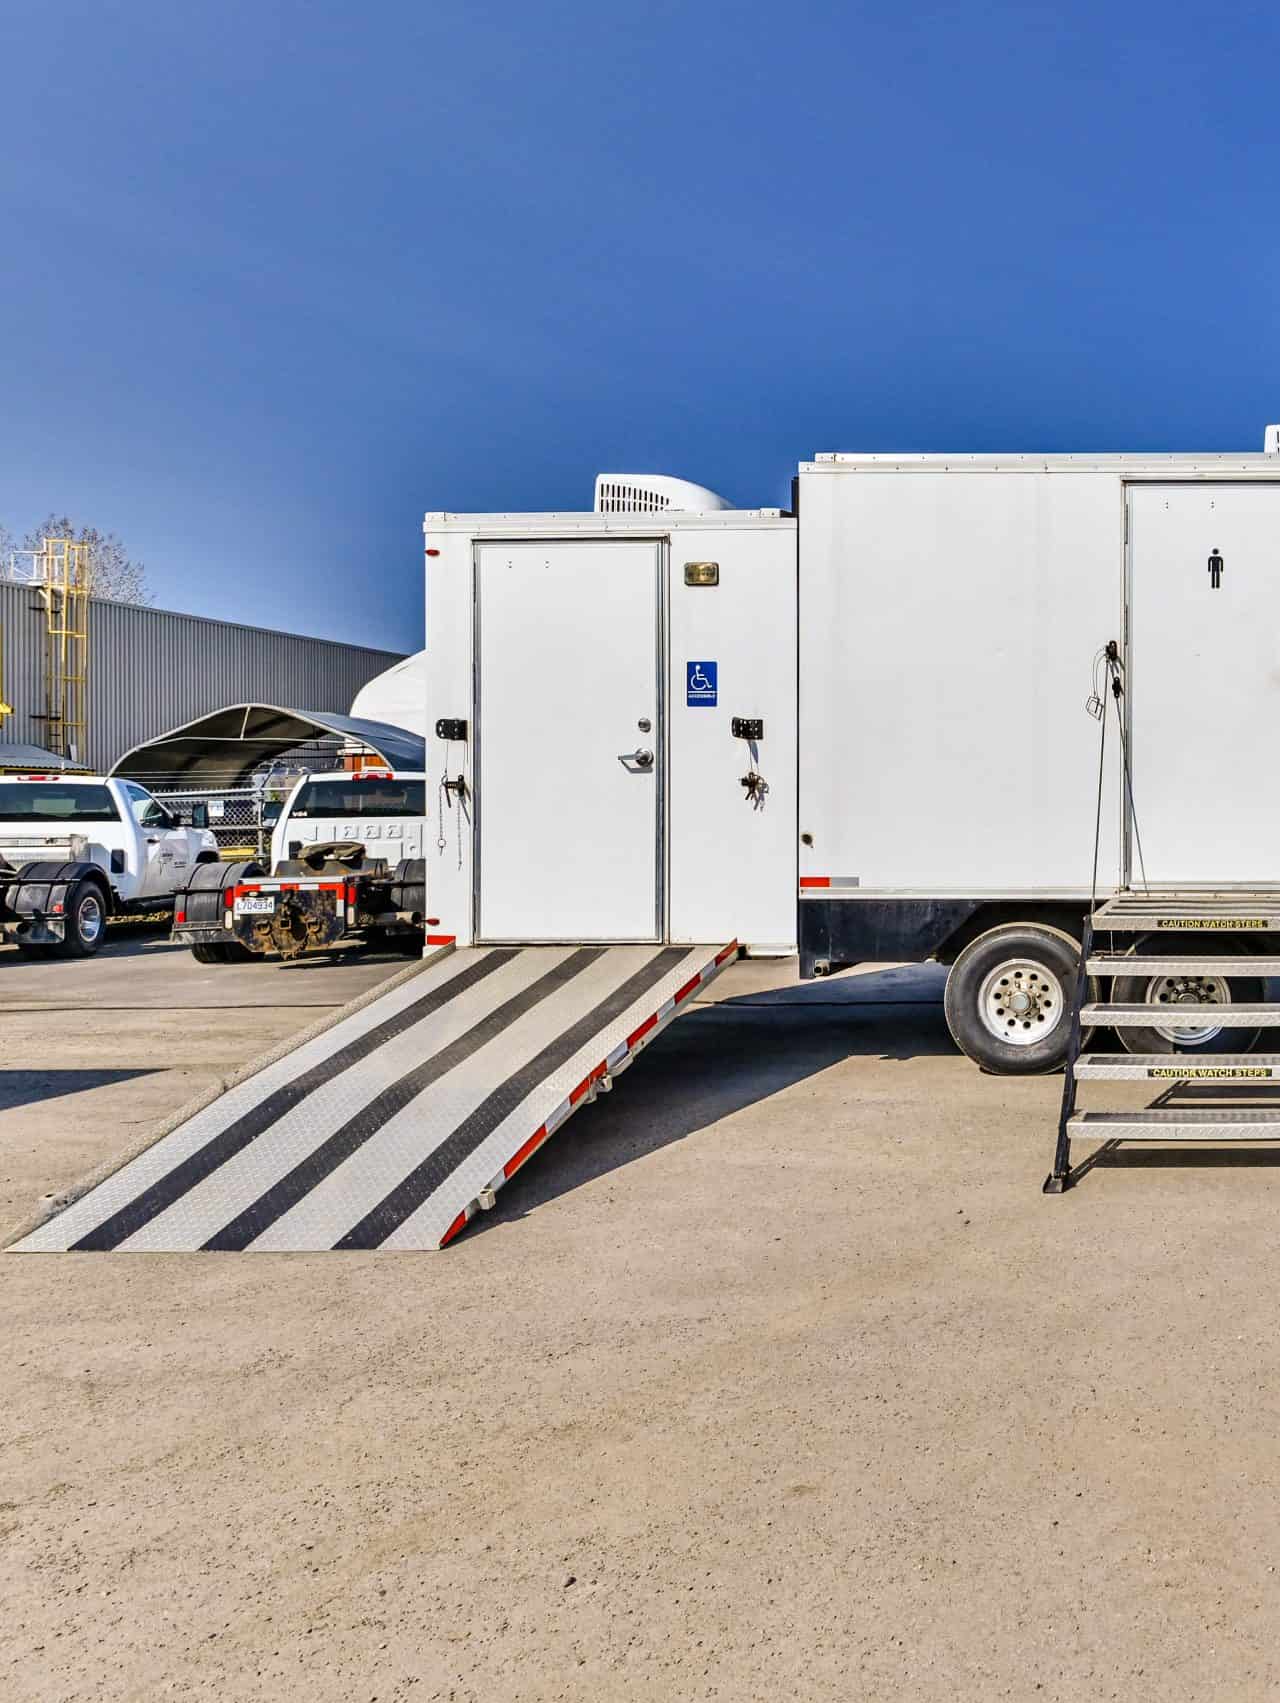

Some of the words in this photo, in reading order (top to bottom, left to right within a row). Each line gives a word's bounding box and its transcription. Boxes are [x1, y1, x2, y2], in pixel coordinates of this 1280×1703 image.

[1161, 920, 1200, 929] CAUTION
[1152, 1068, 1196, 1078] CAUTION
[1197, 1068, 1233, 1078] WATCH
[1235, 1068, 1267, 1078] STEPS
